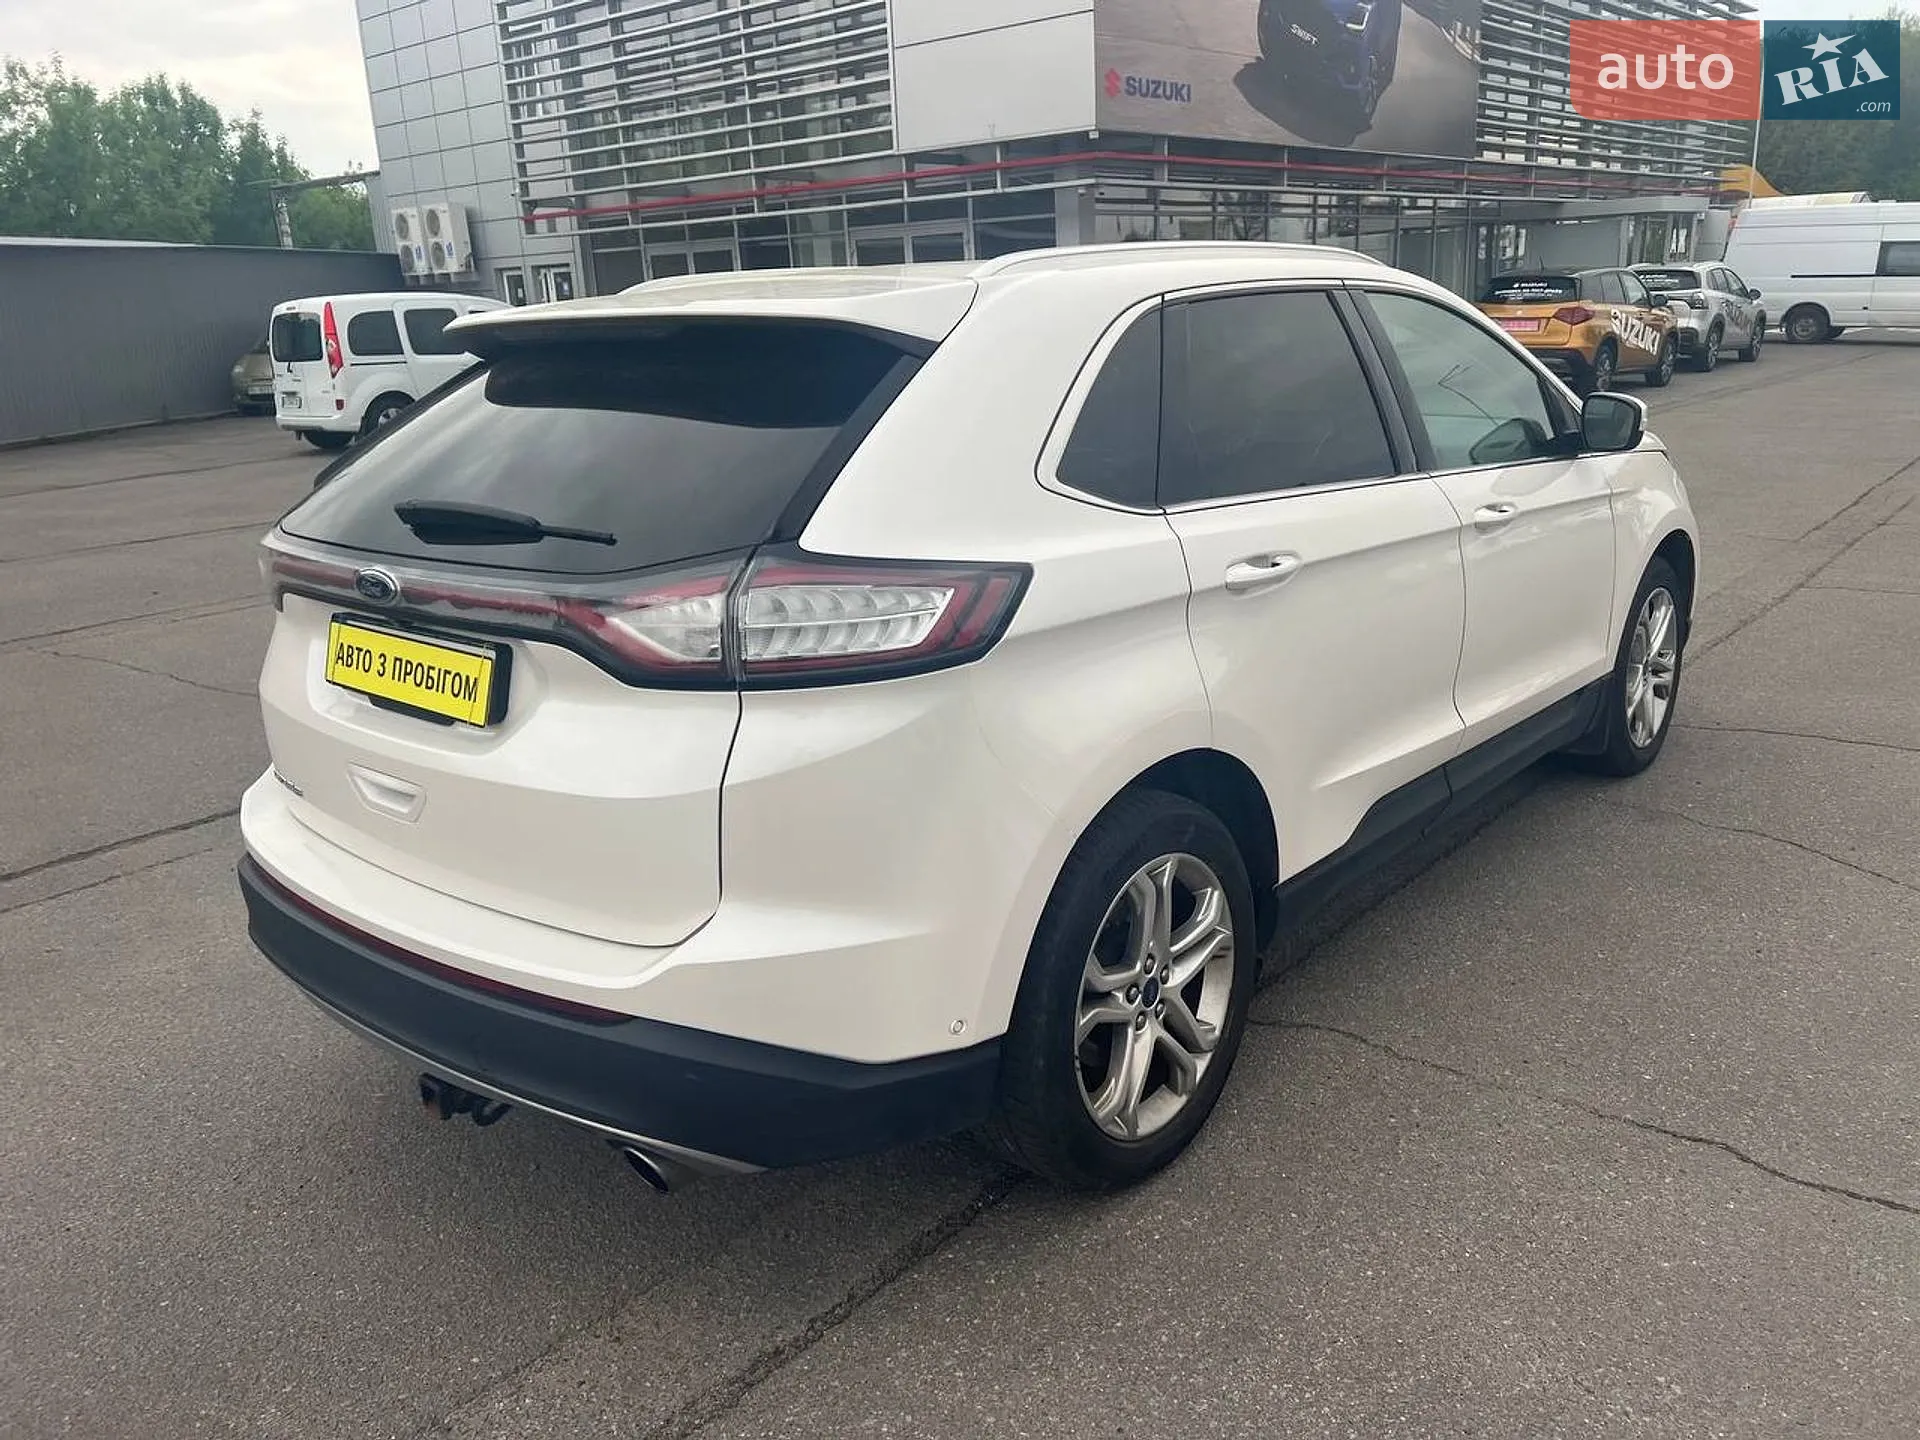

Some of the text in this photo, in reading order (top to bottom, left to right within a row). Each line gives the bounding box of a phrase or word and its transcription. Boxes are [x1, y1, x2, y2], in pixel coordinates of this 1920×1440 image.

[1124, 75, 1191, 103] SUZUKI
[1610, 308, 1661, 356] SUZUKI
[335, 642, 373, 673] АВТО
[391, 656, 479, 703] ПРОБІГОМ
